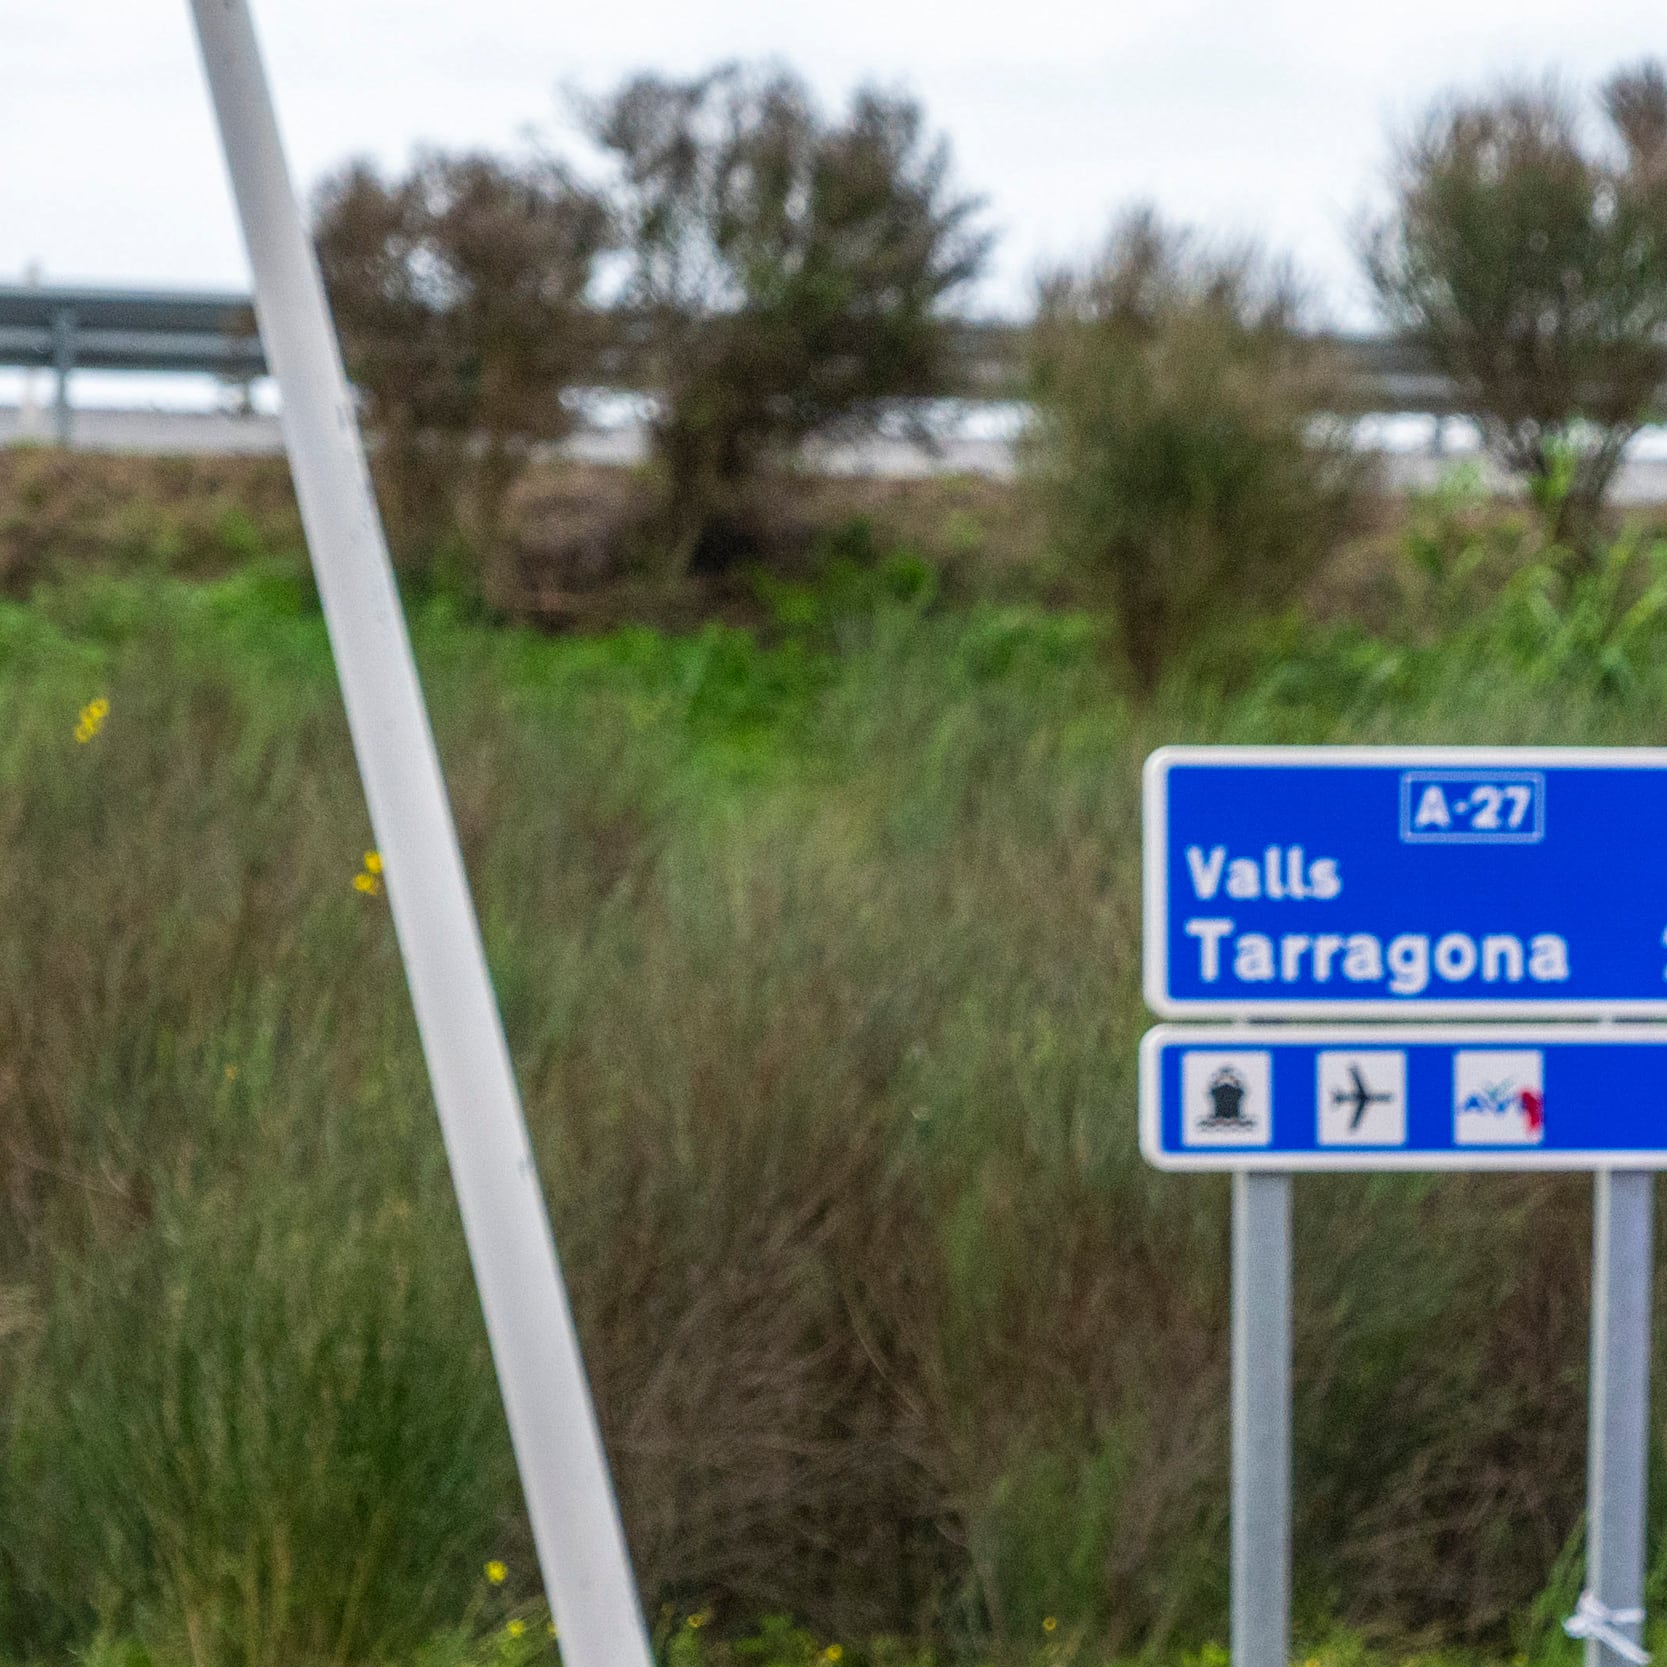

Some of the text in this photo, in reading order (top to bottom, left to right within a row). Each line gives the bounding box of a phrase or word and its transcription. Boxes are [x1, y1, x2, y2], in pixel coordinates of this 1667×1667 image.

[1414, 785, 1532, 829] A-27
[1185, 844, 1341, 899] Valls
[1185, 917, 1570, 995] Tarragona
